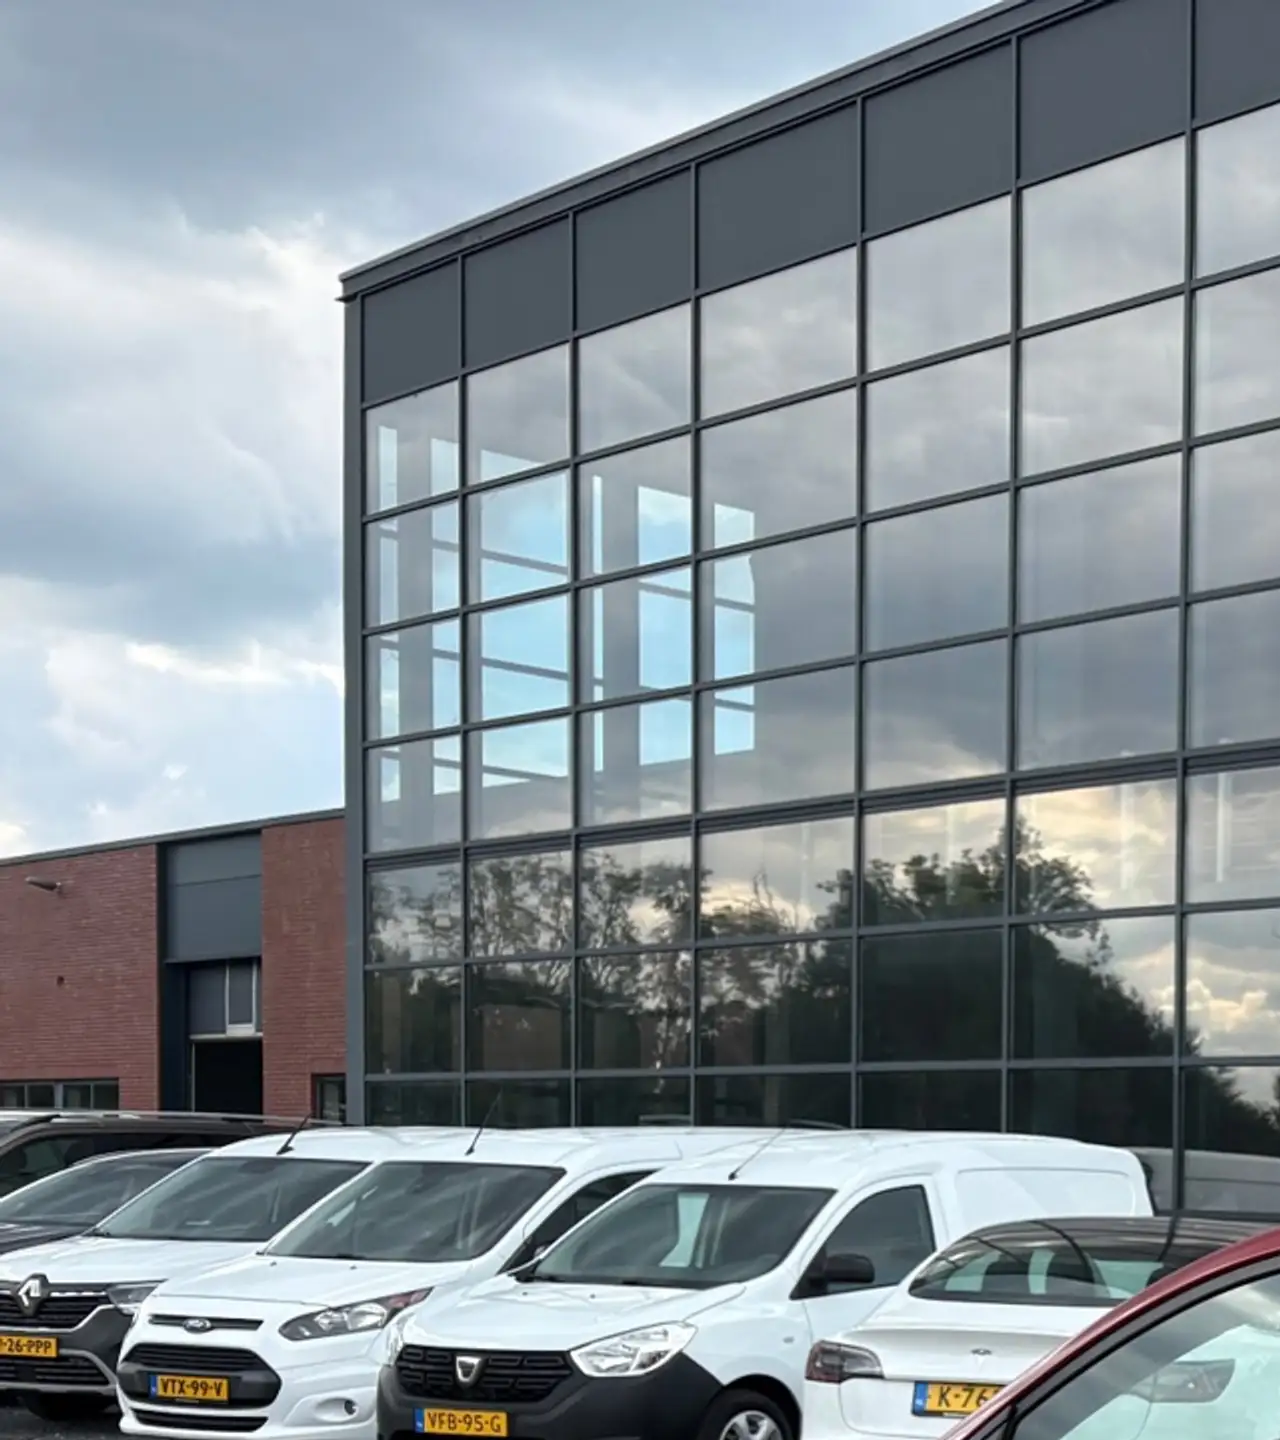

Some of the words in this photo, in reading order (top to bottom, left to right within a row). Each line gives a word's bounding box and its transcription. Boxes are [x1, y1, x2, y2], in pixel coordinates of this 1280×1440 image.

[0, 1337, 52, 1354] -26-PPP
[160, 1378, 224, 1397] VTX-99-V
[937, 1385, 1000, 1408] K-76
[427, 1411, 502, 1433] VFB-95-G
